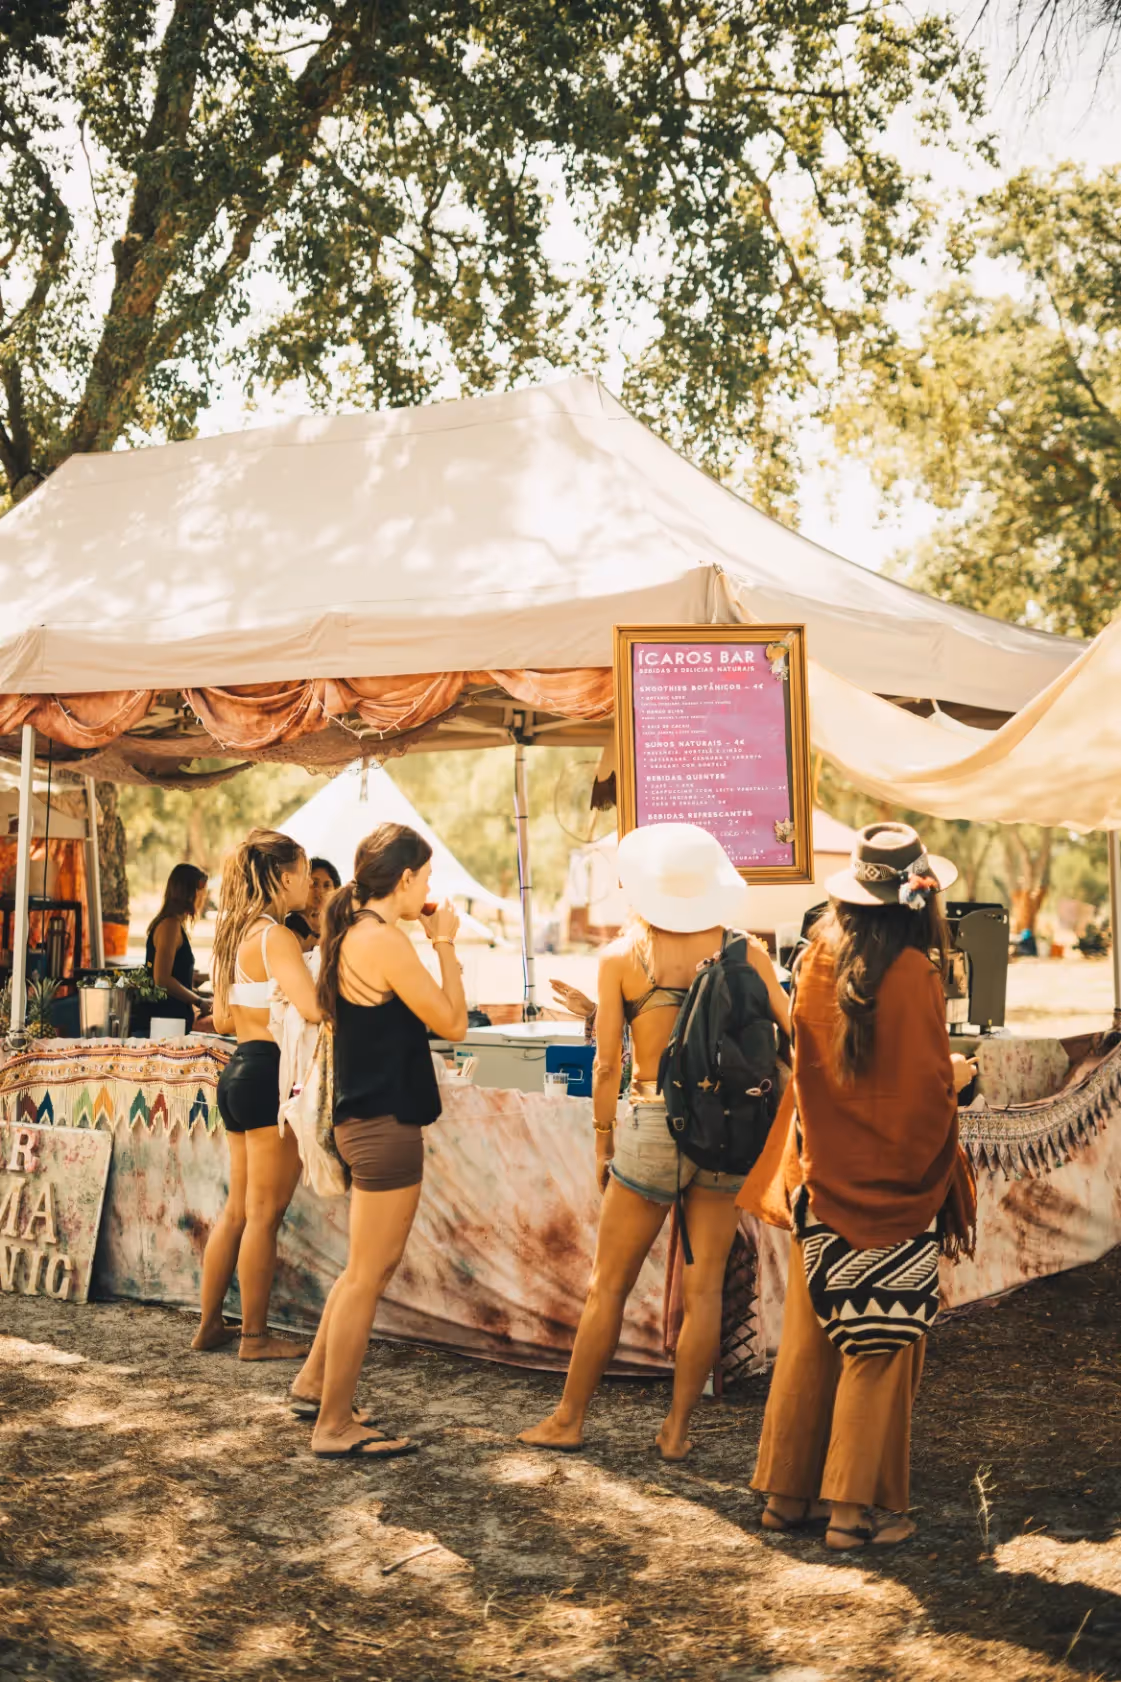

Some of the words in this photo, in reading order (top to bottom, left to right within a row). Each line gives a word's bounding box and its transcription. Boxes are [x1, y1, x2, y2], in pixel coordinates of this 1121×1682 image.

[638, 650, 713, 666] ÍCAROS
[720, 649, 755, 664] BAR
[717, 665, 755, 673] NATURAIS
[639, 685, 688, 693] SMOOTHIES
[644, 741, 675, 749] SUMOS
[678, 739, 722, 747] NATURAIS
[733, 738, 745, 746] 4€
[686, 773, 726, 781] QUENTES
[647, 812, 684, 820] BEBIDAS
[687, 810, 753, 819] REFRESCANTES
[0, 1127, 40, 1173] R
